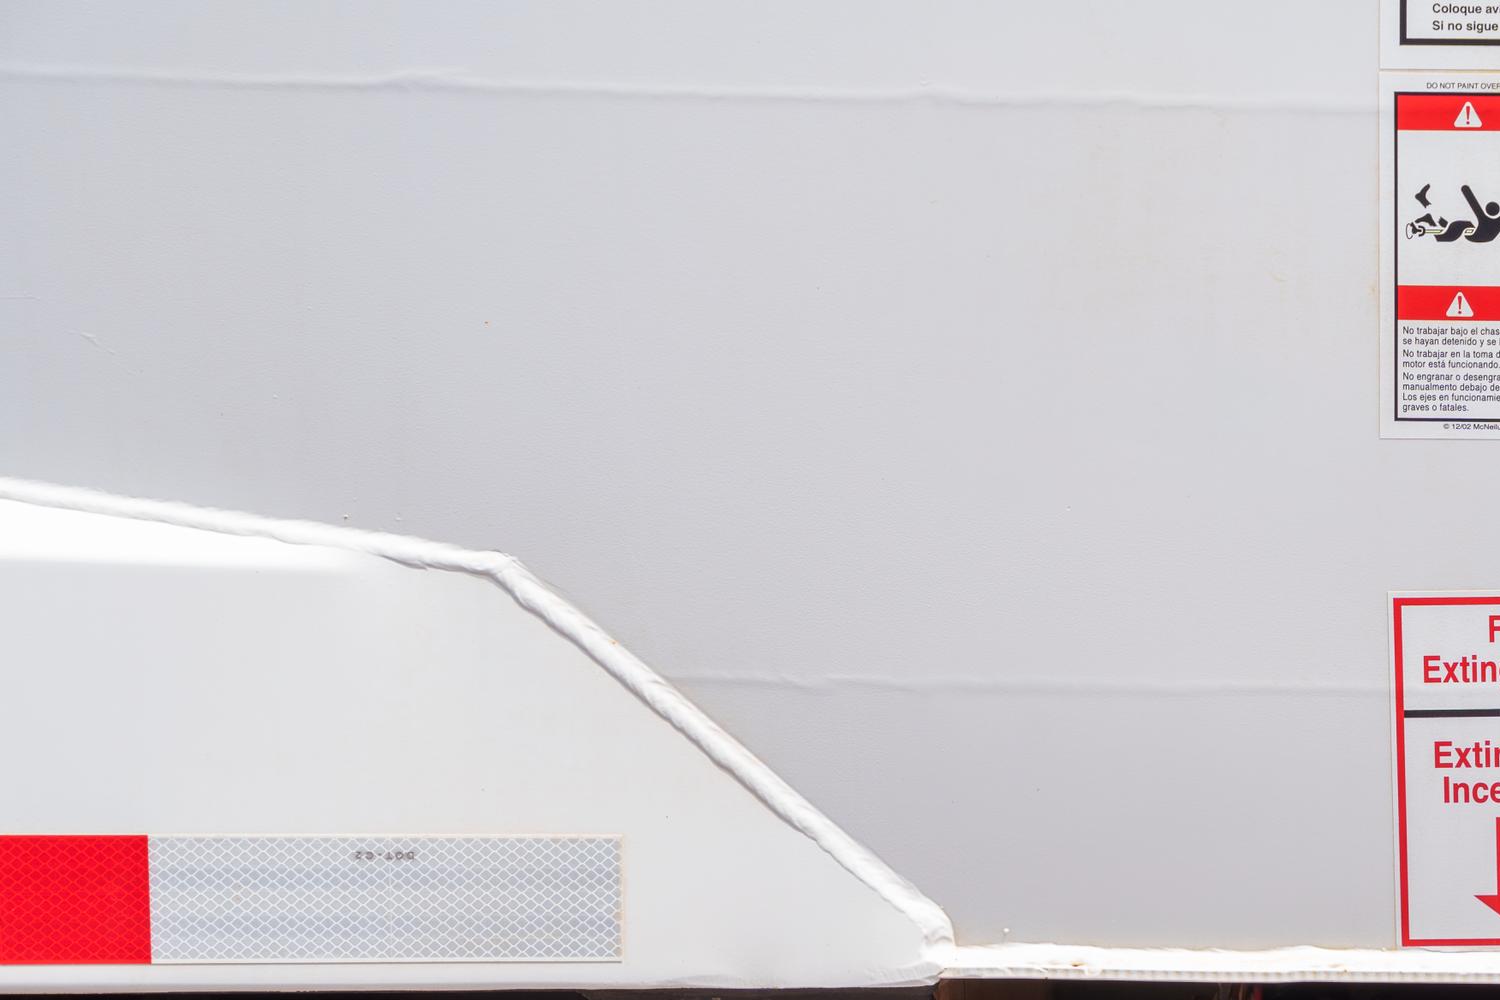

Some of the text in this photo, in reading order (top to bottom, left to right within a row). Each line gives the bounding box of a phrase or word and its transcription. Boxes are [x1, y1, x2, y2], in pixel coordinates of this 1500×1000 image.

[1432, 3, 1482, 17] Coloque
[1432, 19, 1444, 31] Si
[1447, 22, 1463, 31] no
[1466, 20, 1499, 34] sigue
[1426, 82, 1438, 90] DO
[1439, 82, 1456, 90] NOT
[1457, 82, 1479, 90] PAINT
[1402, 326, 1415, 335] No
[1416, 326, 1449, 337] trabajar
[1450, 326, 1469, 338] bajo
[1470, 326, 1478, 335] el
[1402, 359, 1500, 368] motor está funcionando.
[1402, 404, 1430, 414] graves
[1439, 402, 1469, 412] fatales.
